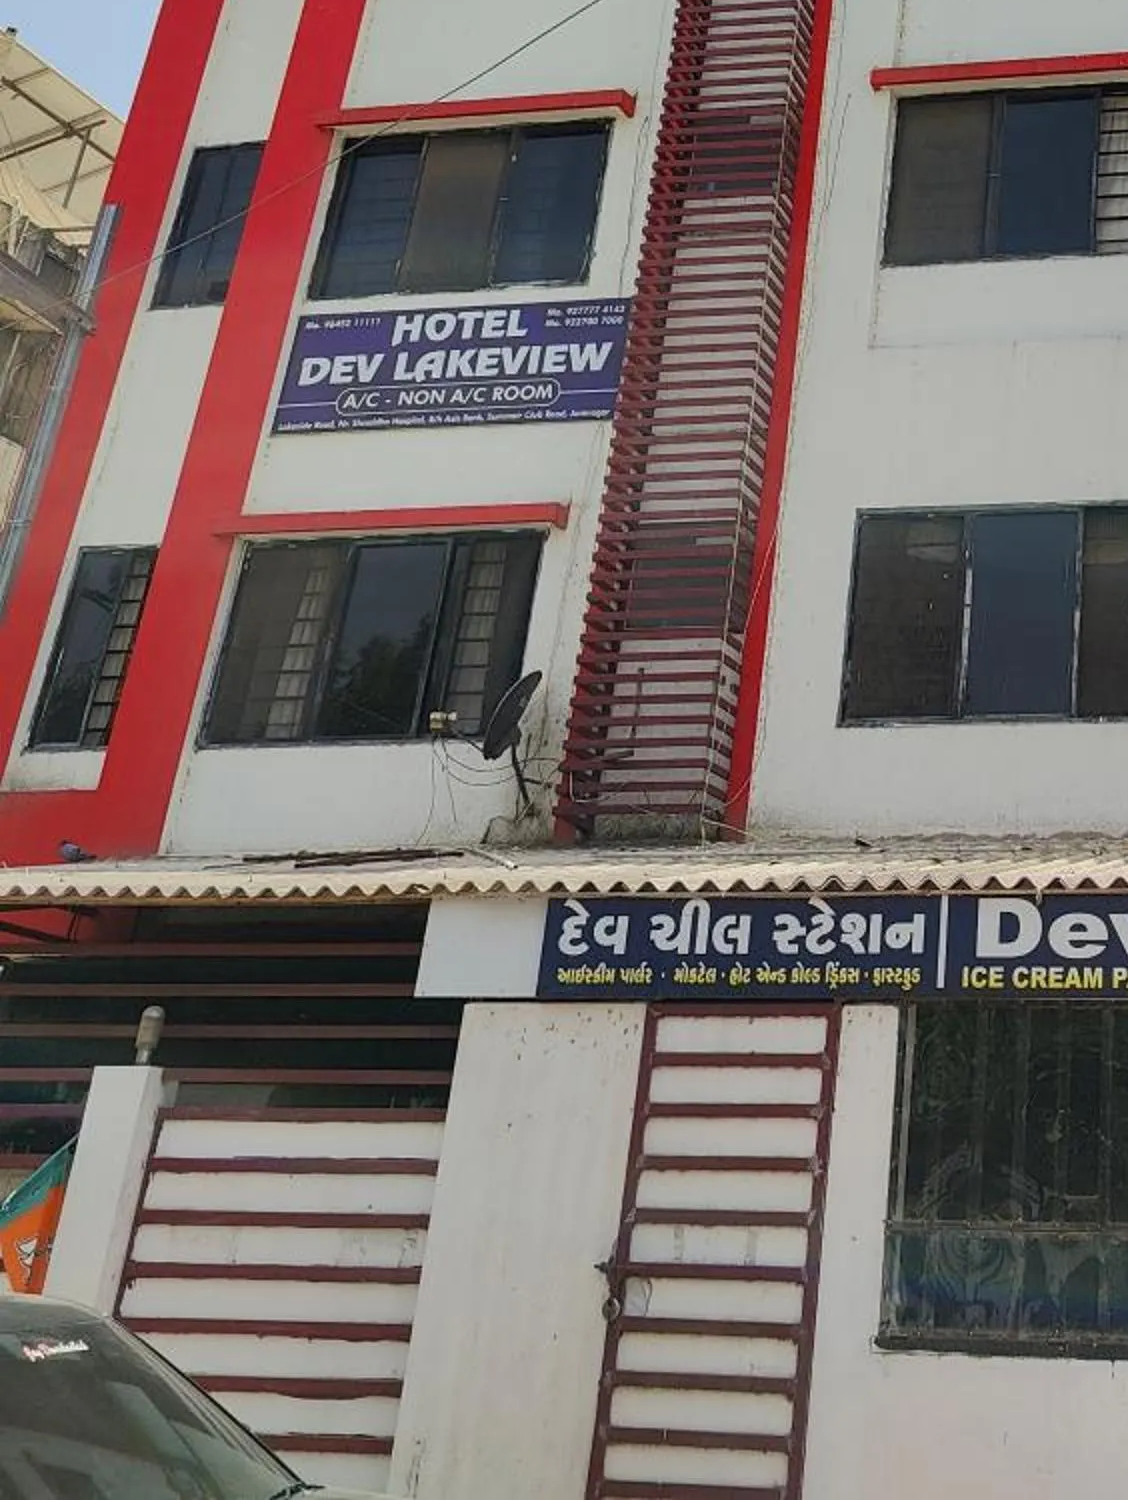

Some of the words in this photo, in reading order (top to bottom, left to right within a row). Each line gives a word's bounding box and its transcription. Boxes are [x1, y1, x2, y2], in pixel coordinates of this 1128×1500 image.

[391, 308, 529, 346] HOTEL
[298, 353, 385, 387] DEV
[393, 341, 613, 382] LAKEVIEW
[342, 393, 380, 410] A/C
[398, 388, 446, 406] NON
[450, 387, 487, 404] A/C
[492, 383, 554, 401] ROOM
[557, 896, 631, 956] દેવ
[648, 898, 752, 956] ચીલ
[771, 896, 926, 956] સ્ટેશન
[961, 966, 1005, 990] ICE
[1012, 966, 1103, 990] CREAM
